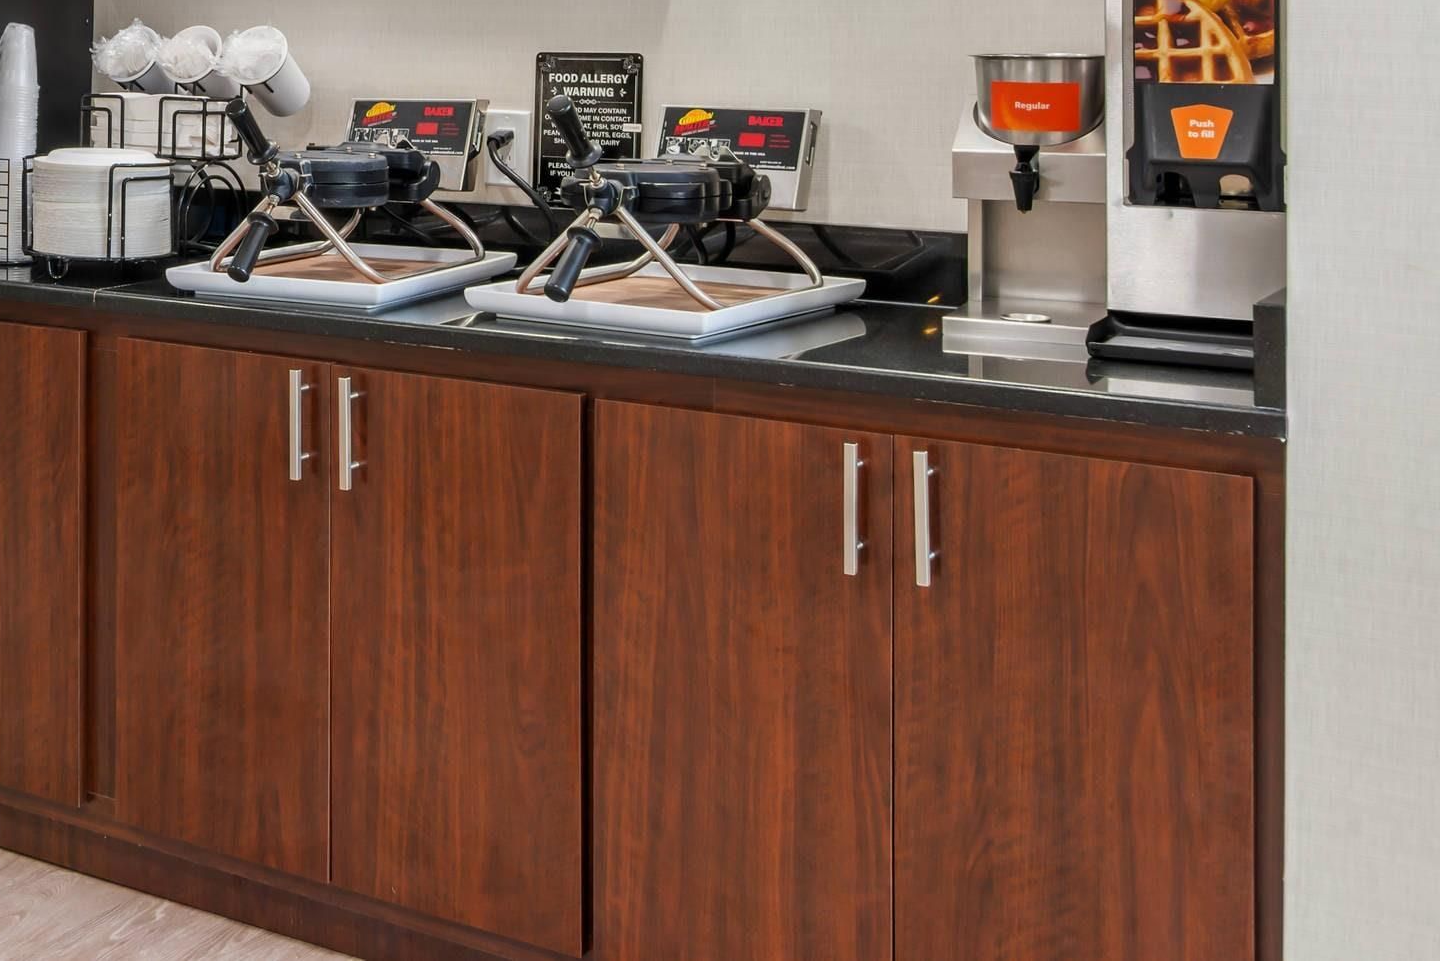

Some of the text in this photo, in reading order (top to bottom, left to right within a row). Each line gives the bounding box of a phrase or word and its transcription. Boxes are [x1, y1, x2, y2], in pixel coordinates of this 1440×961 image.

[549, 73, 629, 84] FOOD ALLERGY
[563, 86, 614, 97] WARNING
[1014, 101, 1050, 111] Regular
[748, 115, 784, 126] BAKER
[1189, 119, 1215, 128] Push
[1188, 129, 1215, 138] to fill
